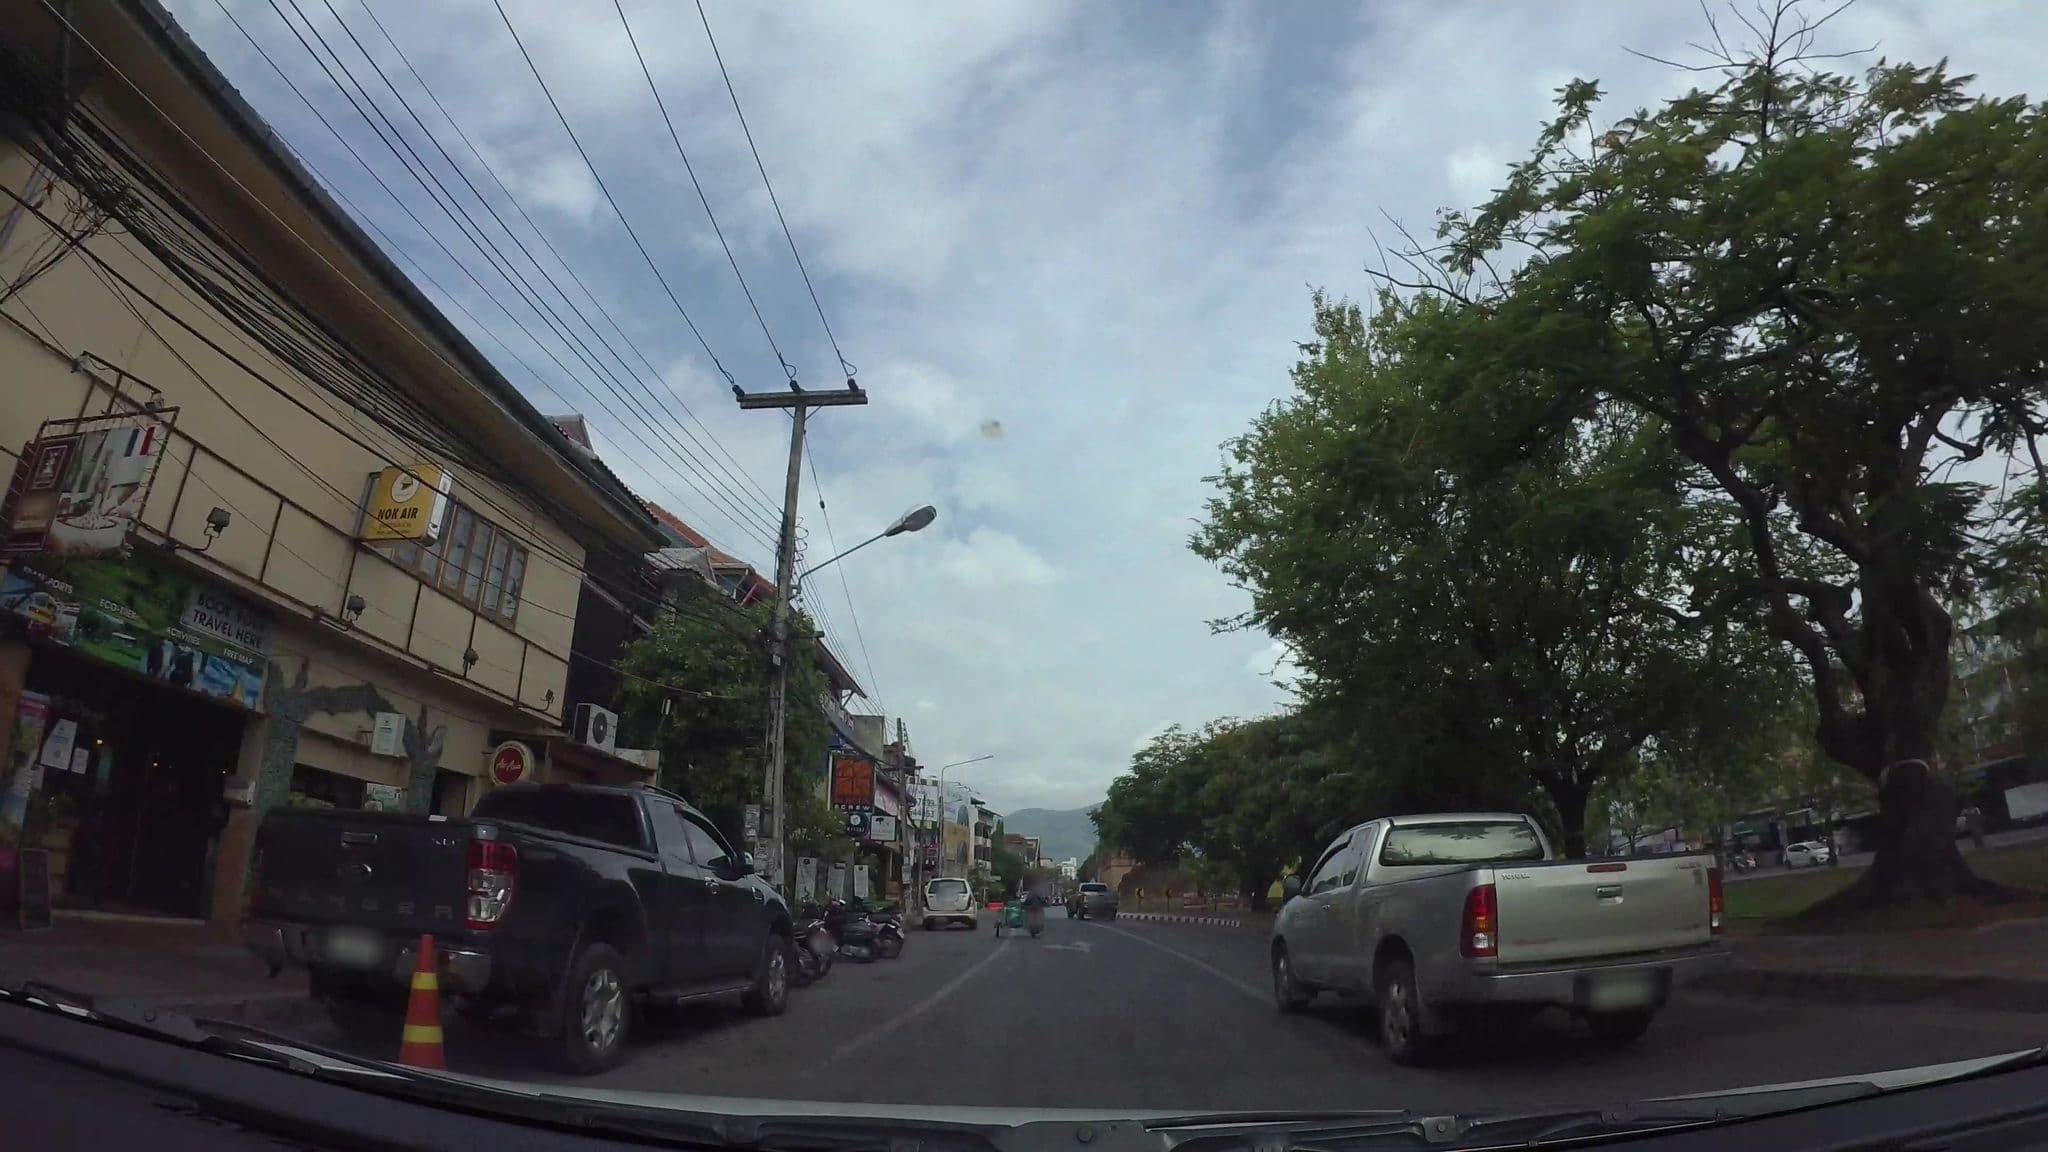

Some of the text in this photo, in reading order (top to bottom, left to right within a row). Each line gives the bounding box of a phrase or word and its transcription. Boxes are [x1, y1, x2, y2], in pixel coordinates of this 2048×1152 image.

[378, 507, 419, 520] NOK AIR
[193, 609, 263, 650] TRAVEL HERE
[268, 885, 452, 919] ANGER
